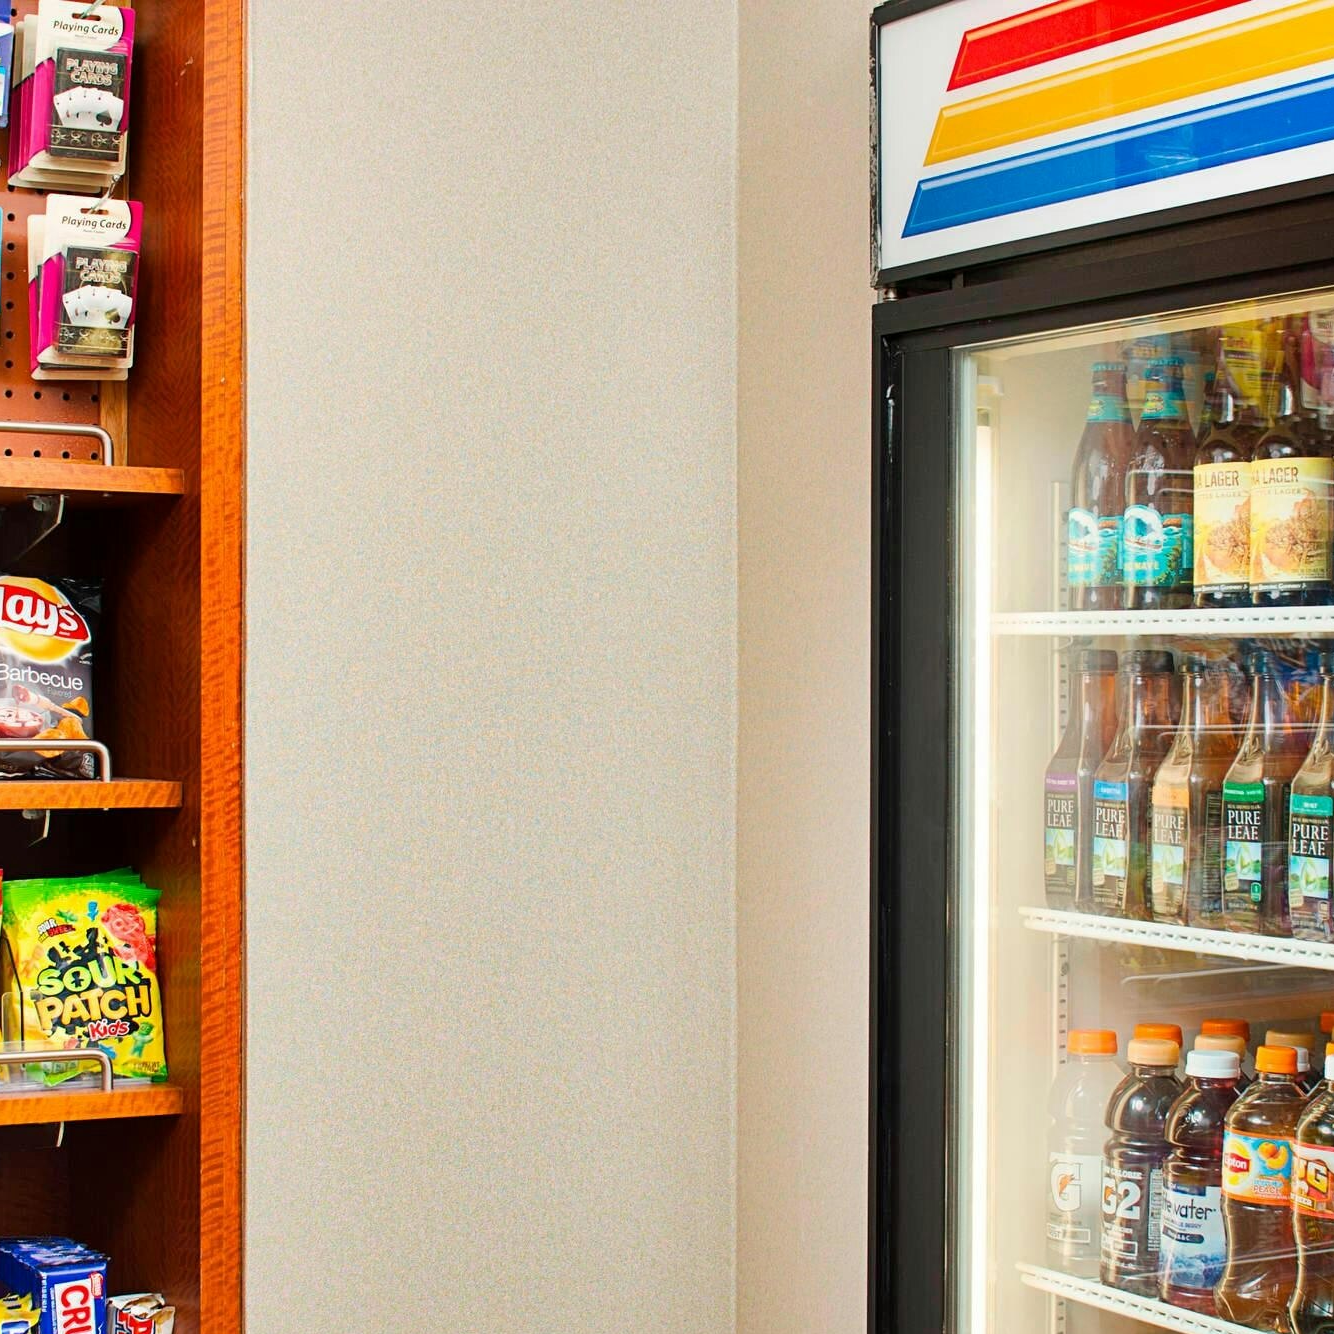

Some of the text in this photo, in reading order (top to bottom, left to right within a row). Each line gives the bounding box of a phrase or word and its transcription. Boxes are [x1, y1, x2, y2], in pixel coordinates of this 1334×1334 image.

[53, 20, 119, 36] Playing Cards
[67, 58, 118, 74] PLAYING
[71, 71, 113, 86] CARDS
[1204, 470, 1240, 488] LAGER
[1262, 466, 1299, 484] LAGER
[1047, 800, 1074, 813] PURE
[1095, 808, 1125, 823] PURE
[36, 985, 151, 1031] PATCH
[88, 1019, 130, 1041] Kids
[1253, 1185, 1281, 1194] PEACH
